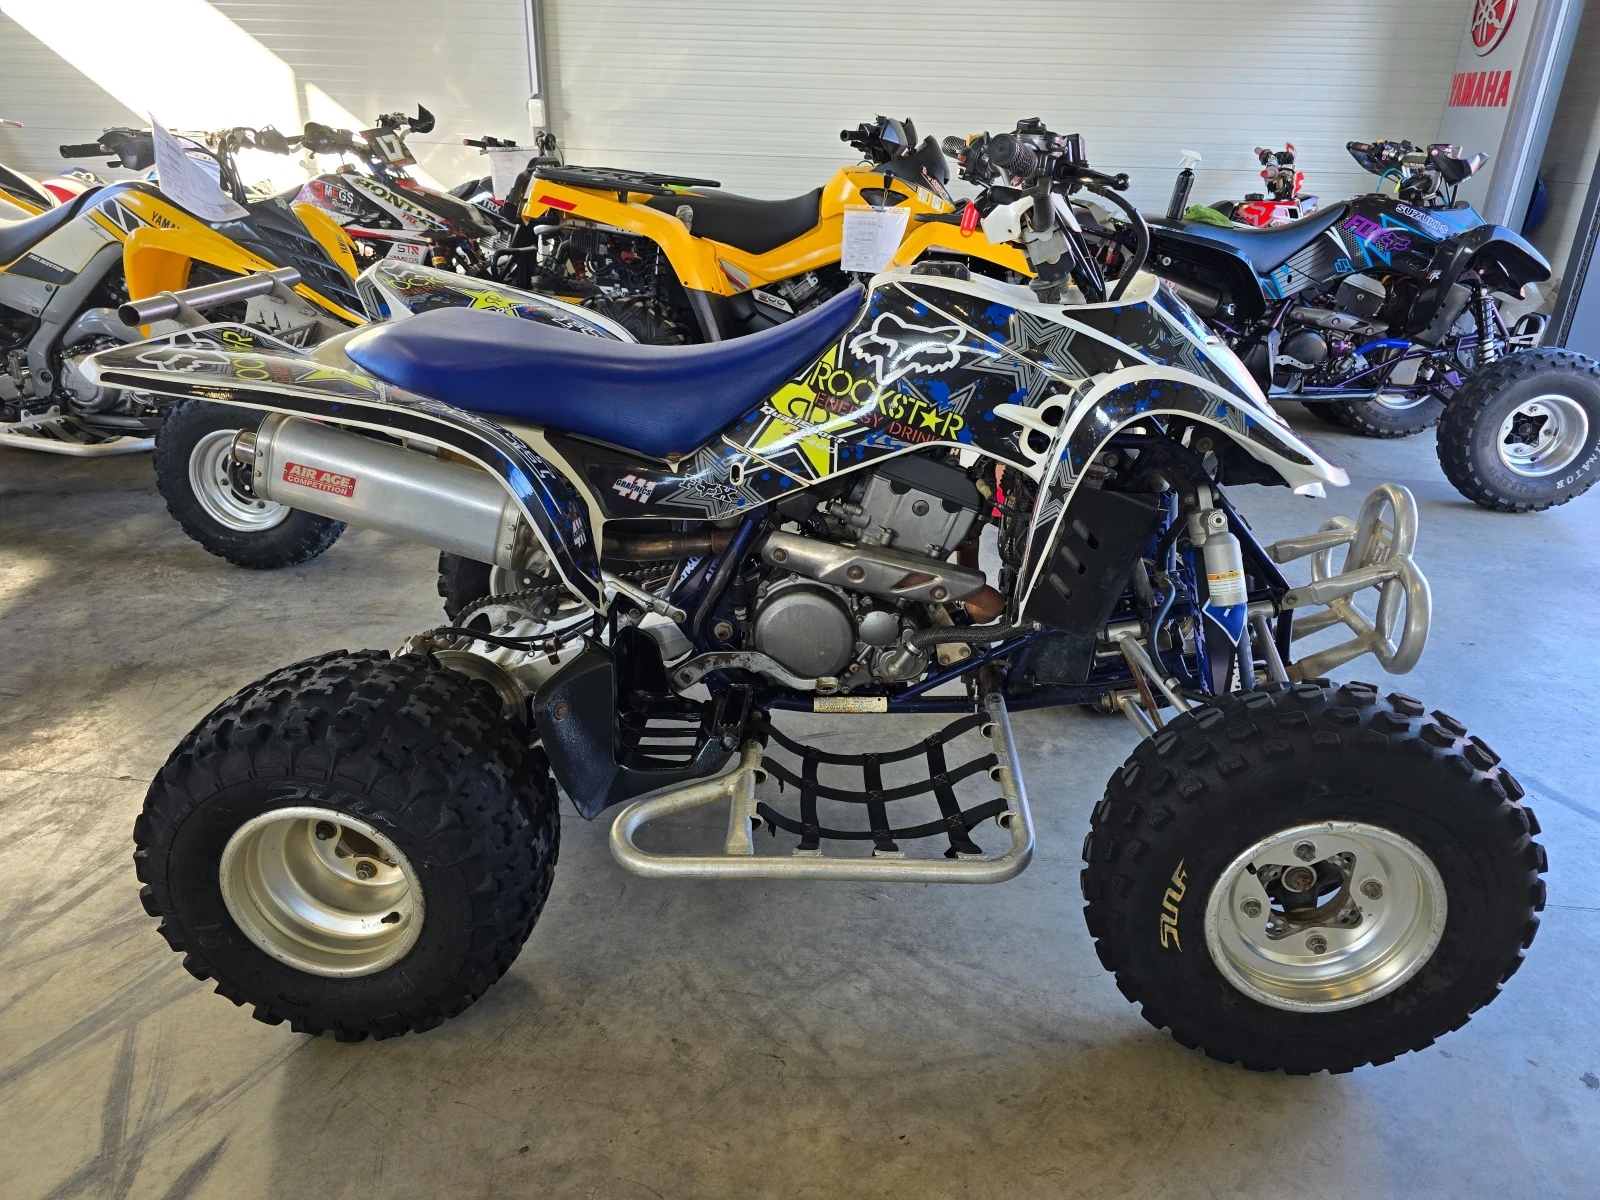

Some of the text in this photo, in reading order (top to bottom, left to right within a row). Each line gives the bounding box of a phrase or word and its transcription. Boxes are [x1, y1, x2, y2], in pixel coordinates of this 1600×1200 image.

[1448, 70, 1513, 107] YAMAHA
[352, 177, 440, 232] HONDA
[481, 198, 502, 215] TRX
[401, 212, 418, 226] TRX
[1395, 203, 1442, 231] SUZUKI
[287, 475, 349, 496] COMPETITION
[289, 464, 351, 488] AIR AGE
[616, 478, 653, 497] GRAPHICS
